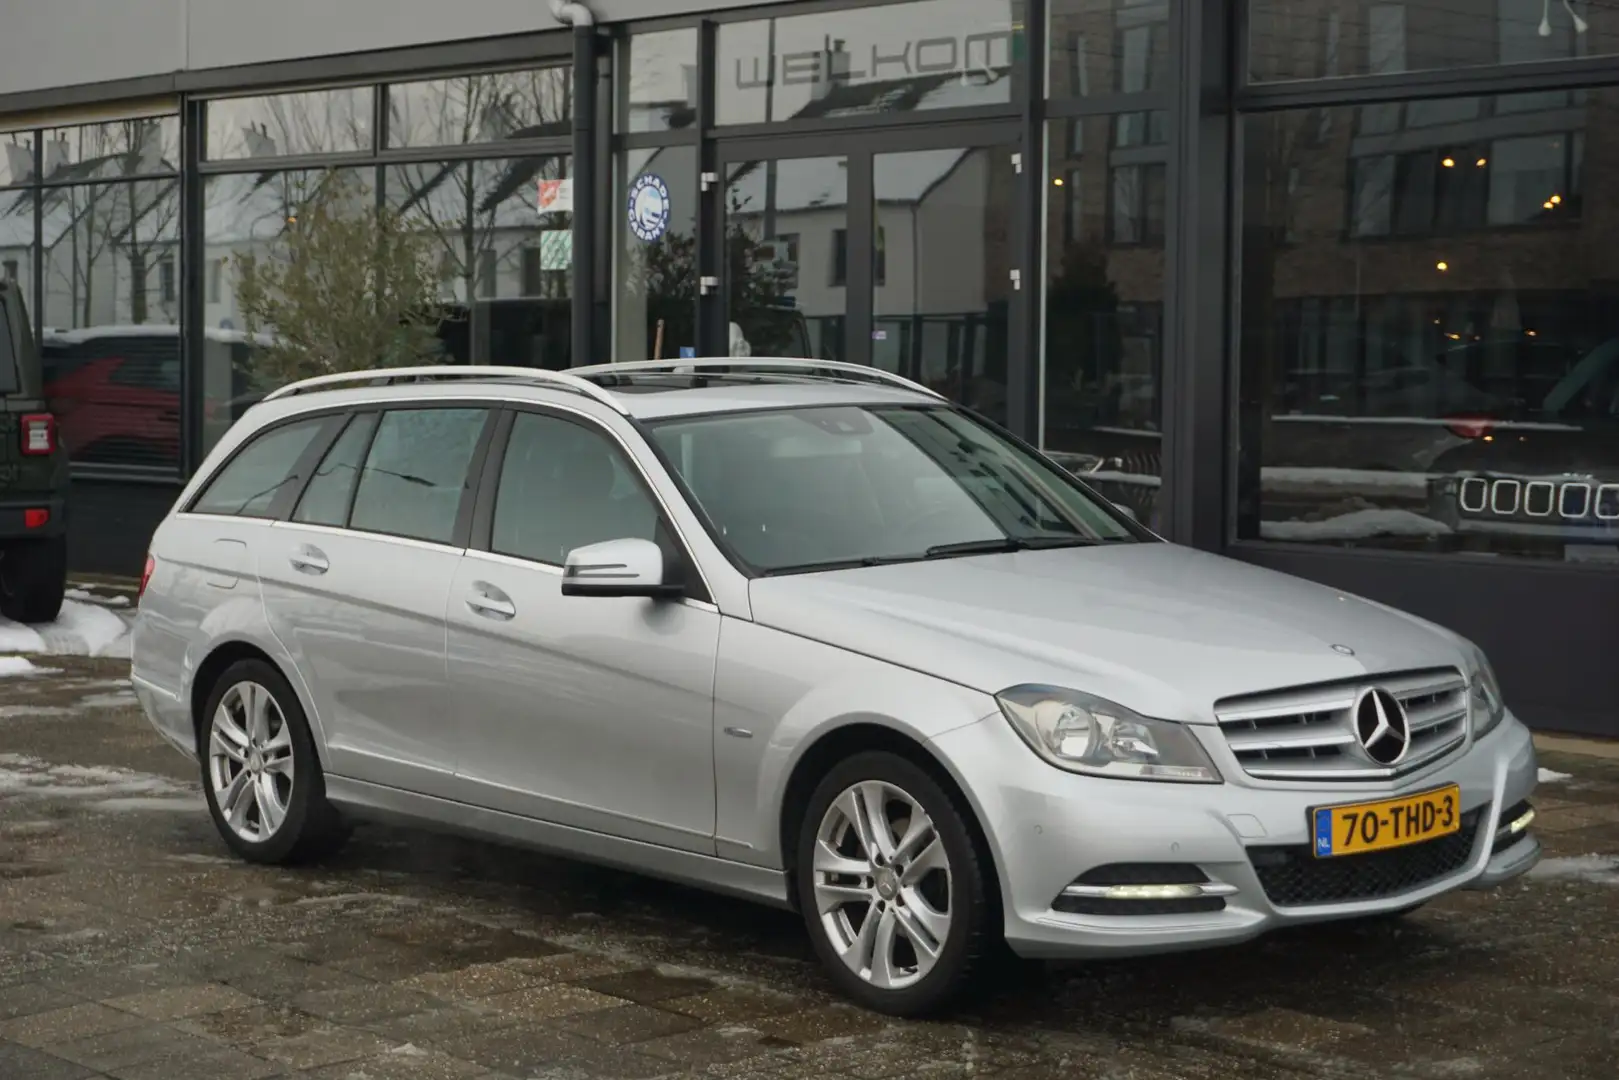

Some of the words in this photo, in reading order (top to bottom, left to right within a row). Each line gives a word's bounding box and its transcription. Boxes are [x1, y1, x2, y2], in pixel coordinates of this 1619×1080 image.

[735, 31, 1012, 89] WELKOM
[1317, 837, 1331, 848] NL
[1342, 795, 1453, 846] 70-THD-3
